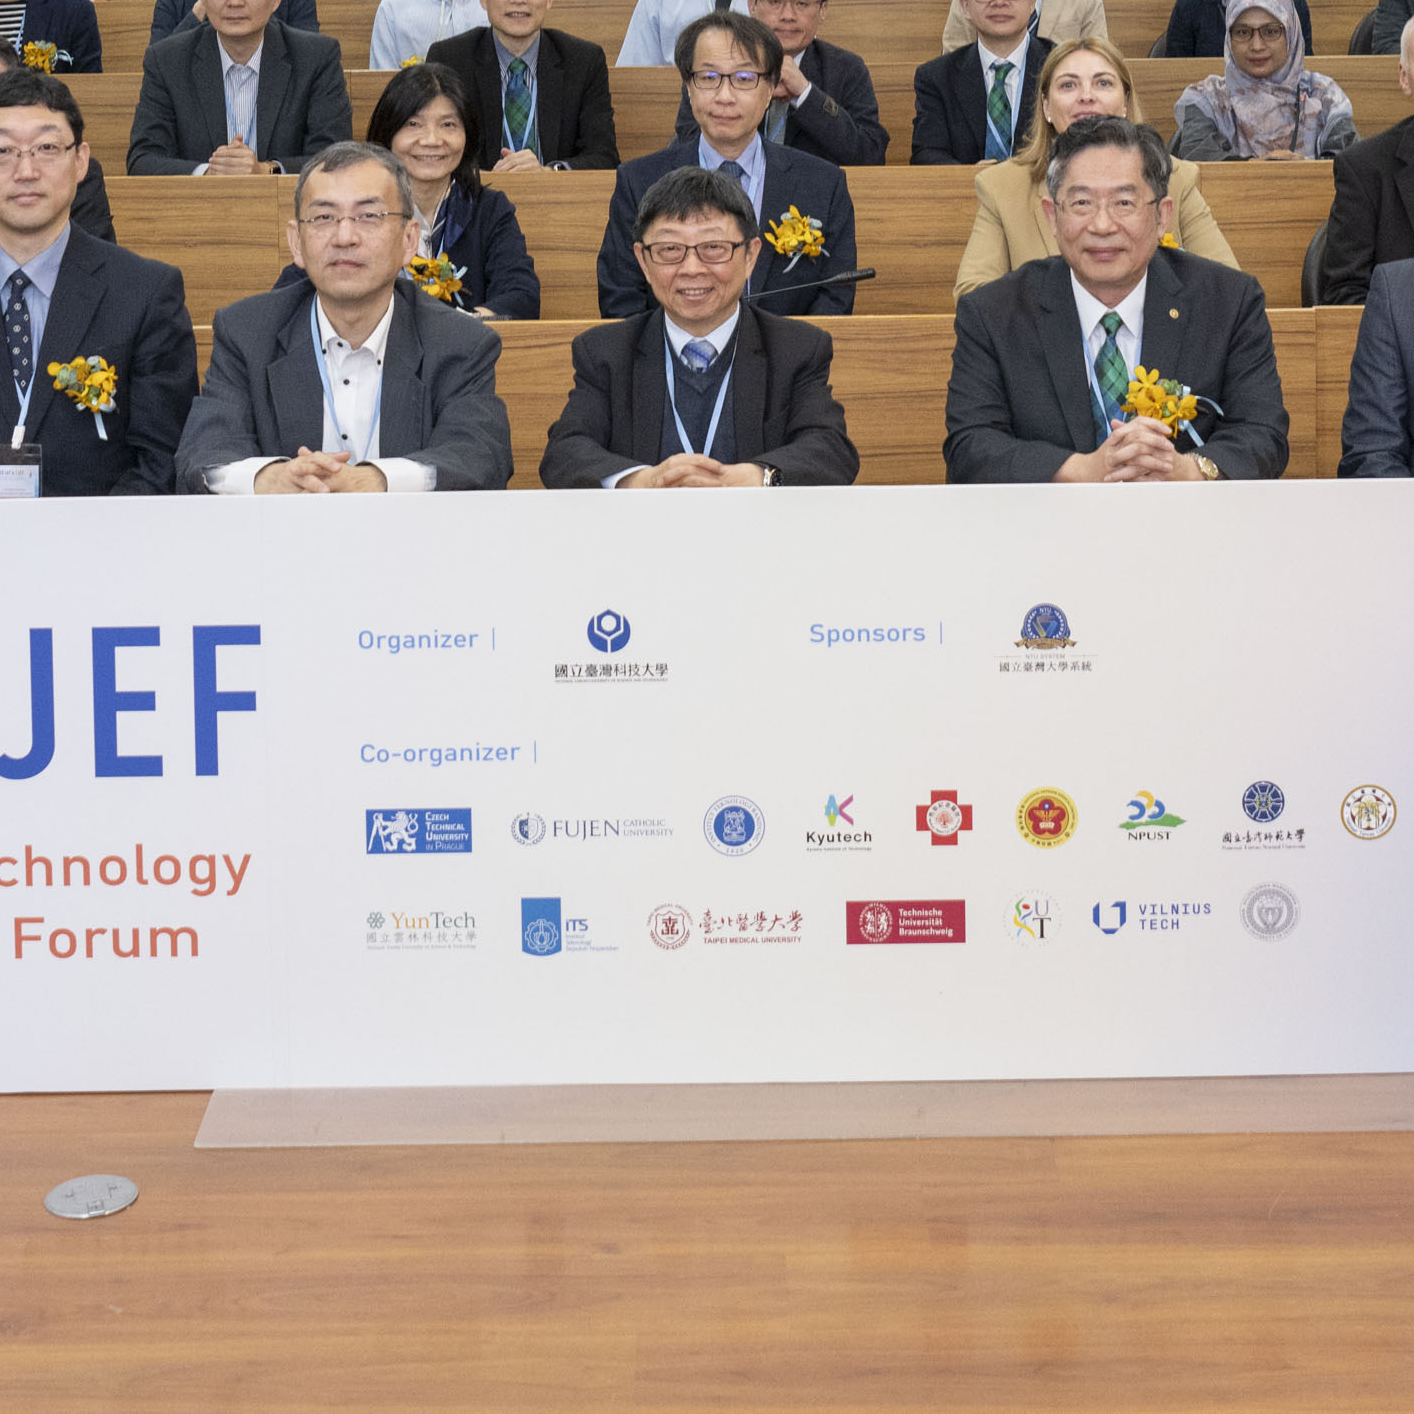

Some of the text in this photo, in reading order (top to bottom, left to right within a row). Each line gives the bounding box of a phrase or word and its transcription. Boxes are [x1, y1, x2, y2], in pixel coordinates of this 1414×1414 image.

[809, 623, 926, 647] Sponsors
[358, 629, 479, 655] Organizer
[555, 663, 669, 678] 國立臺灣科技大學
[999, 660, 1093, 673] 國立臺灣大學系統
[360, 742, 521, 768] Co-organizer
[623, 818, 666, 827] CATHOLIC
[553, 819, 620, 841] FUJEN
[623, 828, 674, 837] UNIVERSITY
[1128, 831, 1171, 841] NPUST
[806, 831, 872, 846] Kyutech
[898, 908, 943, 917] Technische
[1139, 903, 1211, 916] VILNIUS
[390, 911, 476, 929] YunTech
[899, 918, 943, 926] Universität
[1139, 918, 1180, 931] TECH
[13, 916, 199, 960] Forum
[899, 927, 954, 938] Braunschweig
[703, 936, 802, 945] TAIPEI MEDICAL UNIVERSITY
